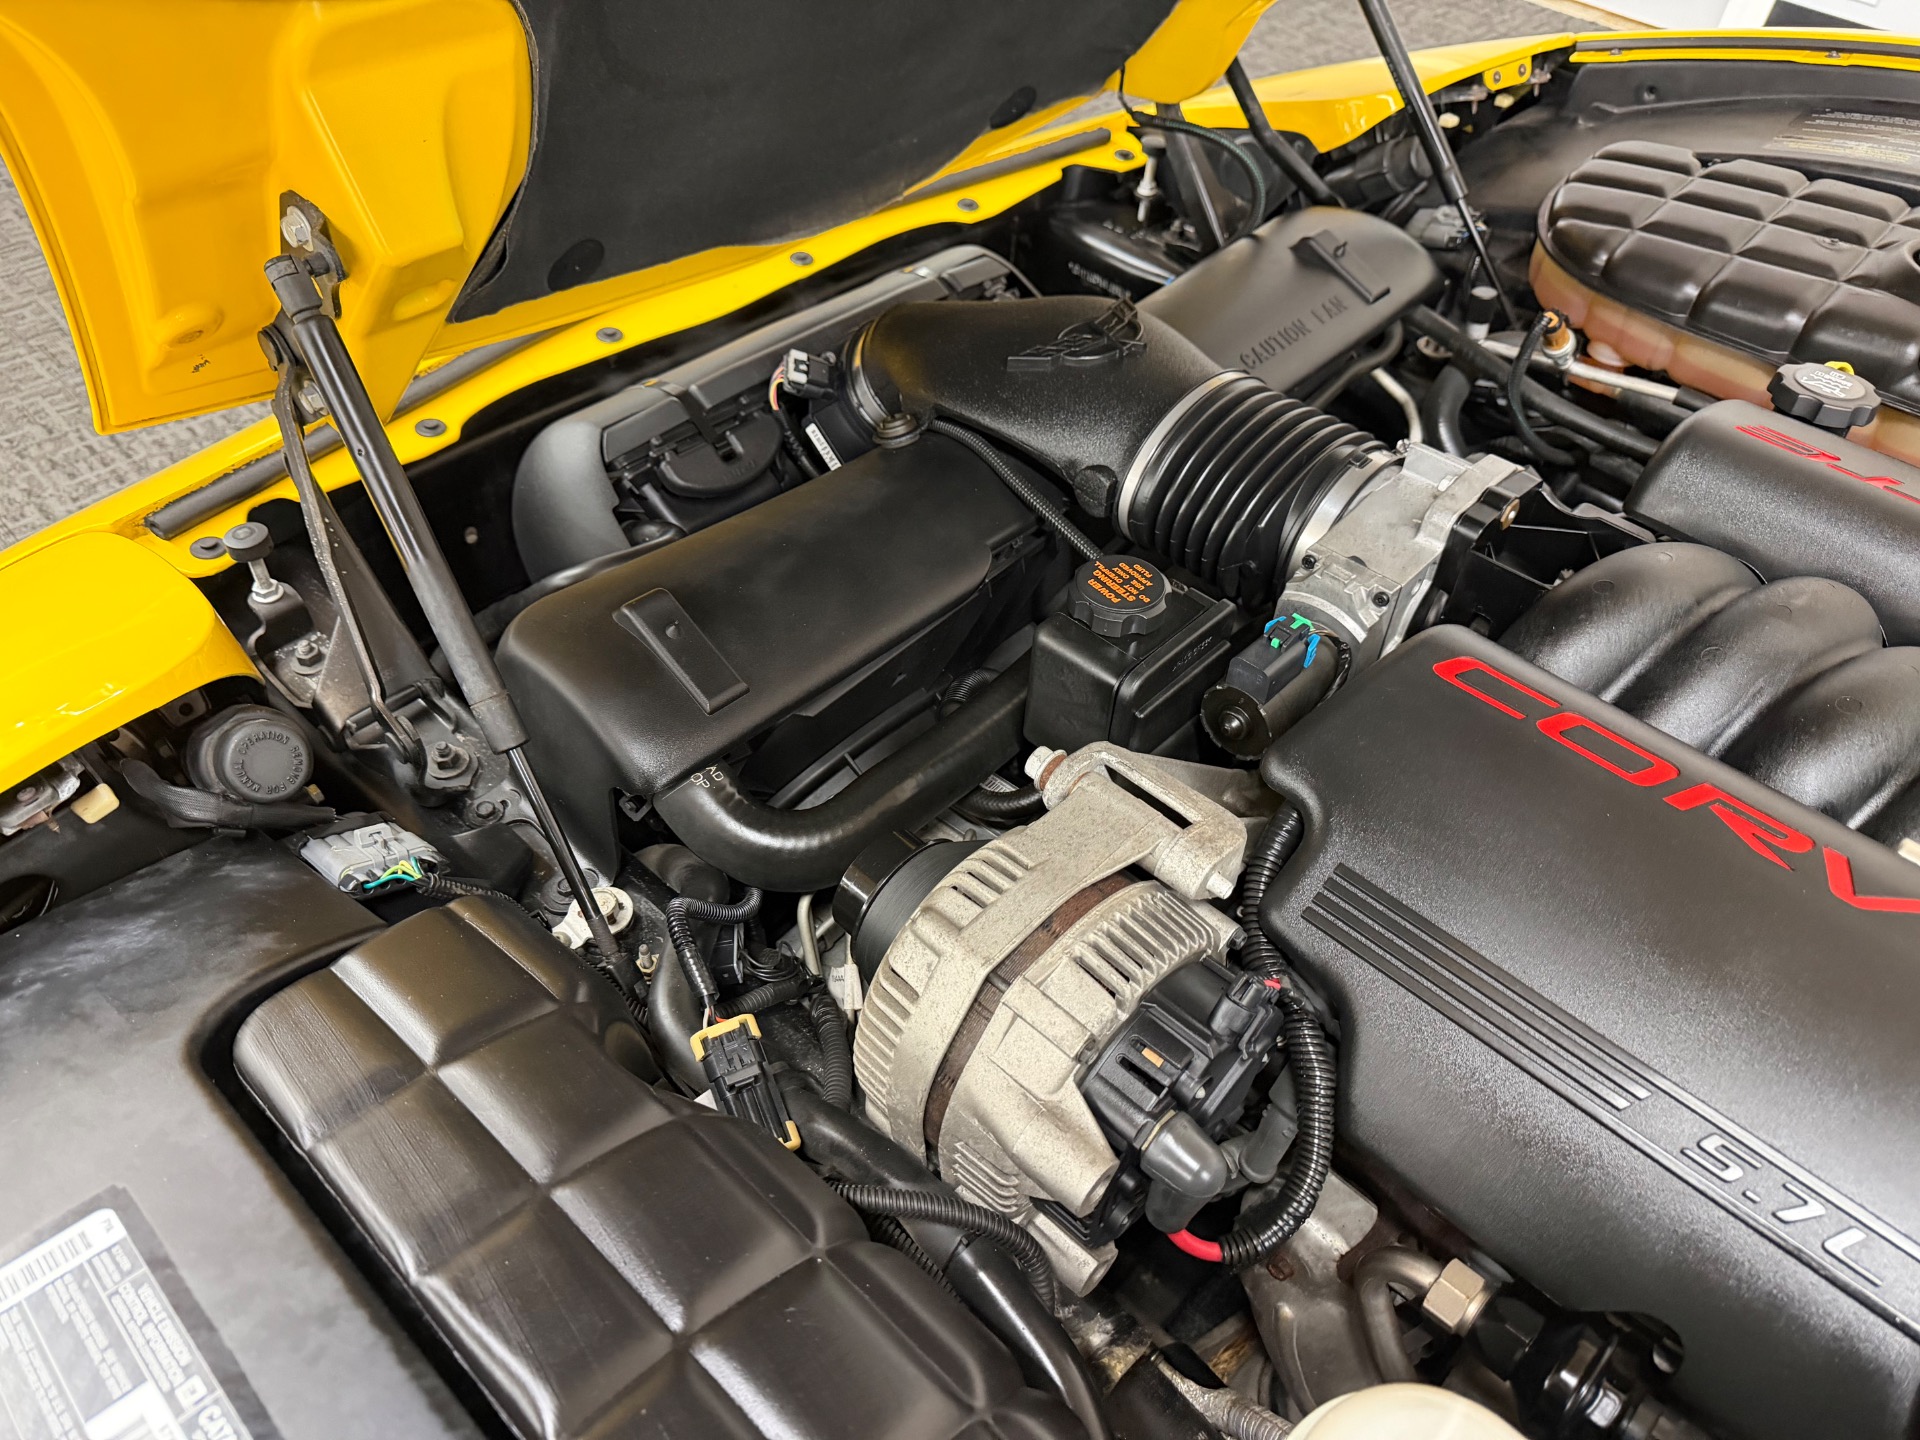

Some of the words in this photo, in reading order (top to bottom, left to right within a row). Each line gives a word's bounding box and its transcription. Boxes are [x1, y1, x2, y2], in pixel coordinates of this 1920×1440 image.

[1239, 318, 1312, 369] CAUTION
[1095, 561, 1123, 583] OVERFILL
[1112, 568, 1129, 579] ONLY
[1119, 563, 1153, 586] APPROVED
[1133, 564, 1152, 578] FLUID
[1088, 579, 1121, 603] POWER
[1093, 570, 1136, 601] STEERING
[1123, 585, 1139, 595] NOT
[1131, 580, 1145, 590] USE
[1139, 595, 1150, 603] DO
[237, 731, 290, 754] OPERATION
[234, 759, 261, 792] MANUAL
[286, 745, 303, 784] REMOVE
[266, 781, 286, 795] FOR
[1680, 1132, 1884, 1287] 5.7L
